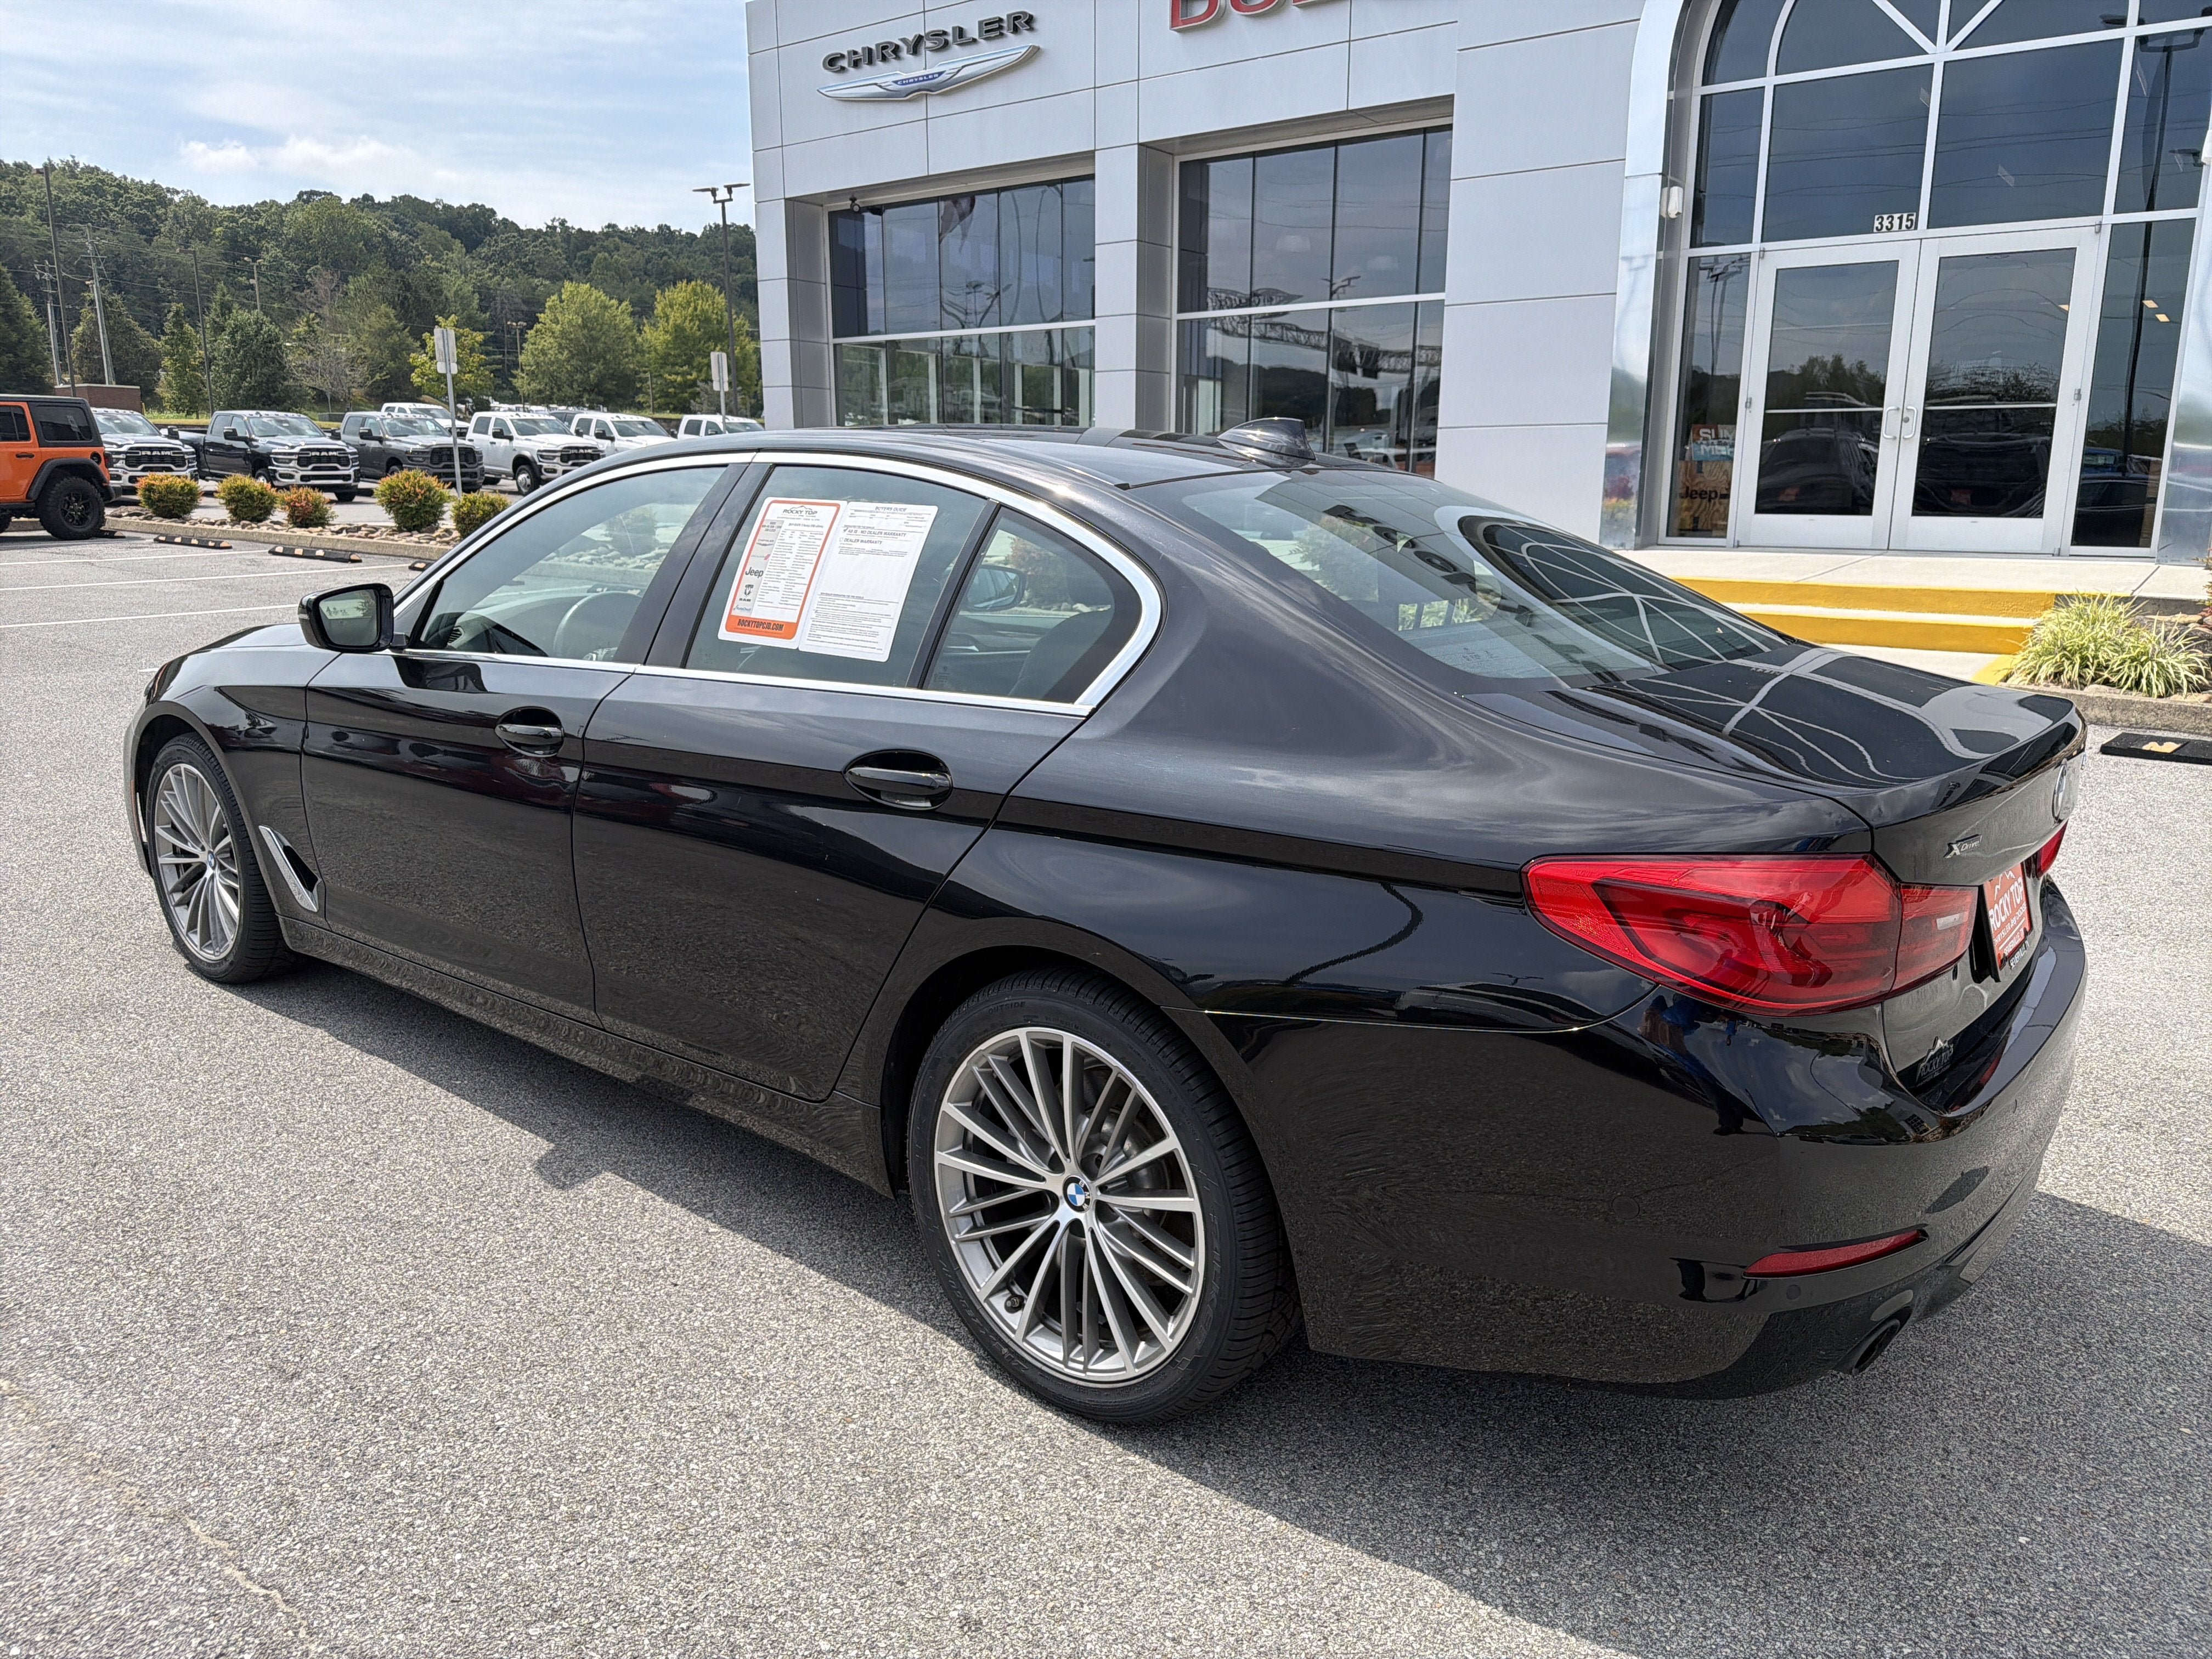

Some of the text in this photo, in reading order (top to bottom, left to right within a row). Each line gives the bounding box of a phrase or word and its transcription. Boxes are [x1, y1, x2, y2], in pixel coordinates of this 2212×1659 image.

[822, 10, 1032, 72] CHRYSLER
[898, 74, 939, 84] CHRYSLER
[1876, 214, 1914, 232] 3315
[1680, 486, 1718, 503] Jeep
[745, 567, 764, 578] Jeep
[737, 618, 784, 631] ROCKYTOPCJD.COM
[1989, 876, 2024, 932] ROCKY TOP
[988, 1001, 1026, 1015] OUTSIDE
[1920, 1054, 1940, 1077] ROCKY
[1079, 1180, 1091, 1210] BMW
[1192, 1214, 1222, 1352] FALKEN
